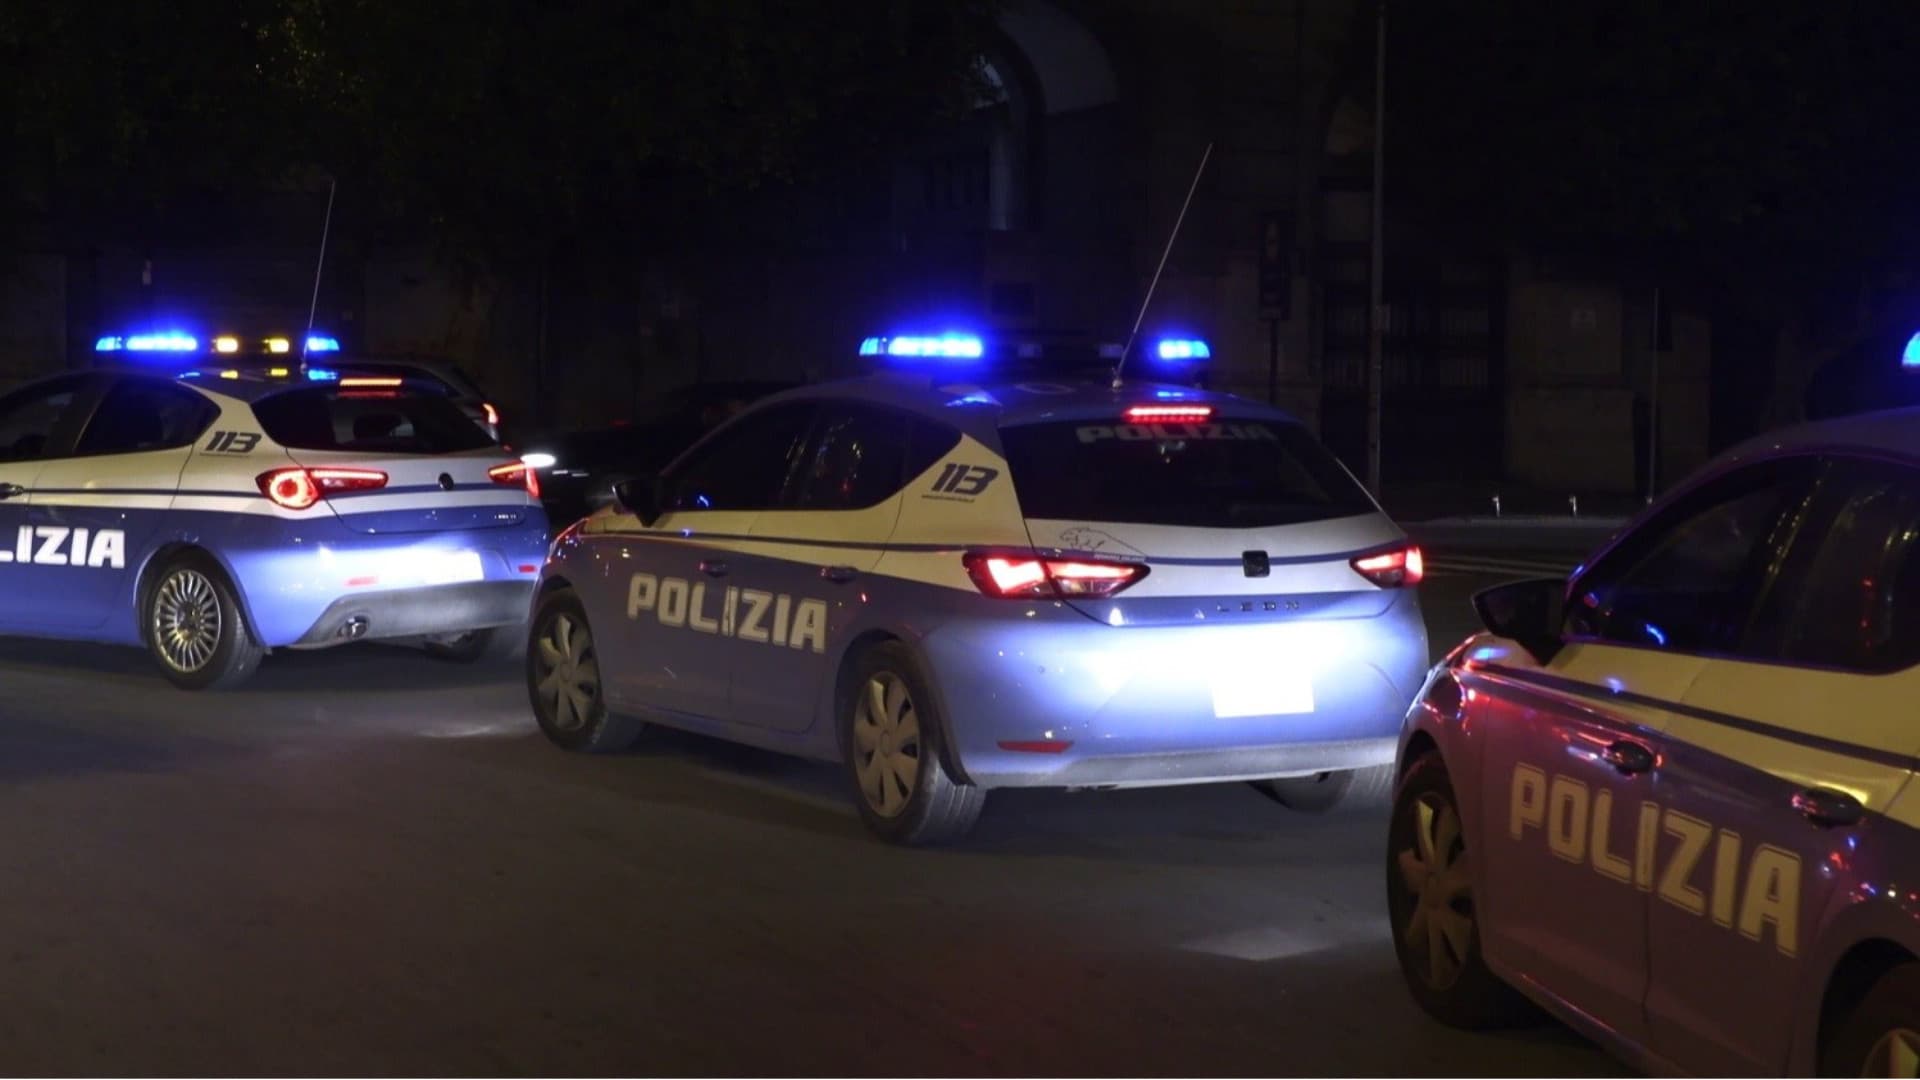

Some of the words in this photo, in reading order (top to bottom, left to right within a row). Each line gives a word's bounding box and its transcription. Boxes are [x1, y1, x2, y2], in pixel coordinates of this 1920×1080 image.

[205, 431, 262, 453] 113
[1076, 423, 1279, 443] POLIZIA
[931, 463, 998, 496] 113
[627, 572, 827, 654] POLIZIA
[1509, 761, 1801, 959] POLIZIA
